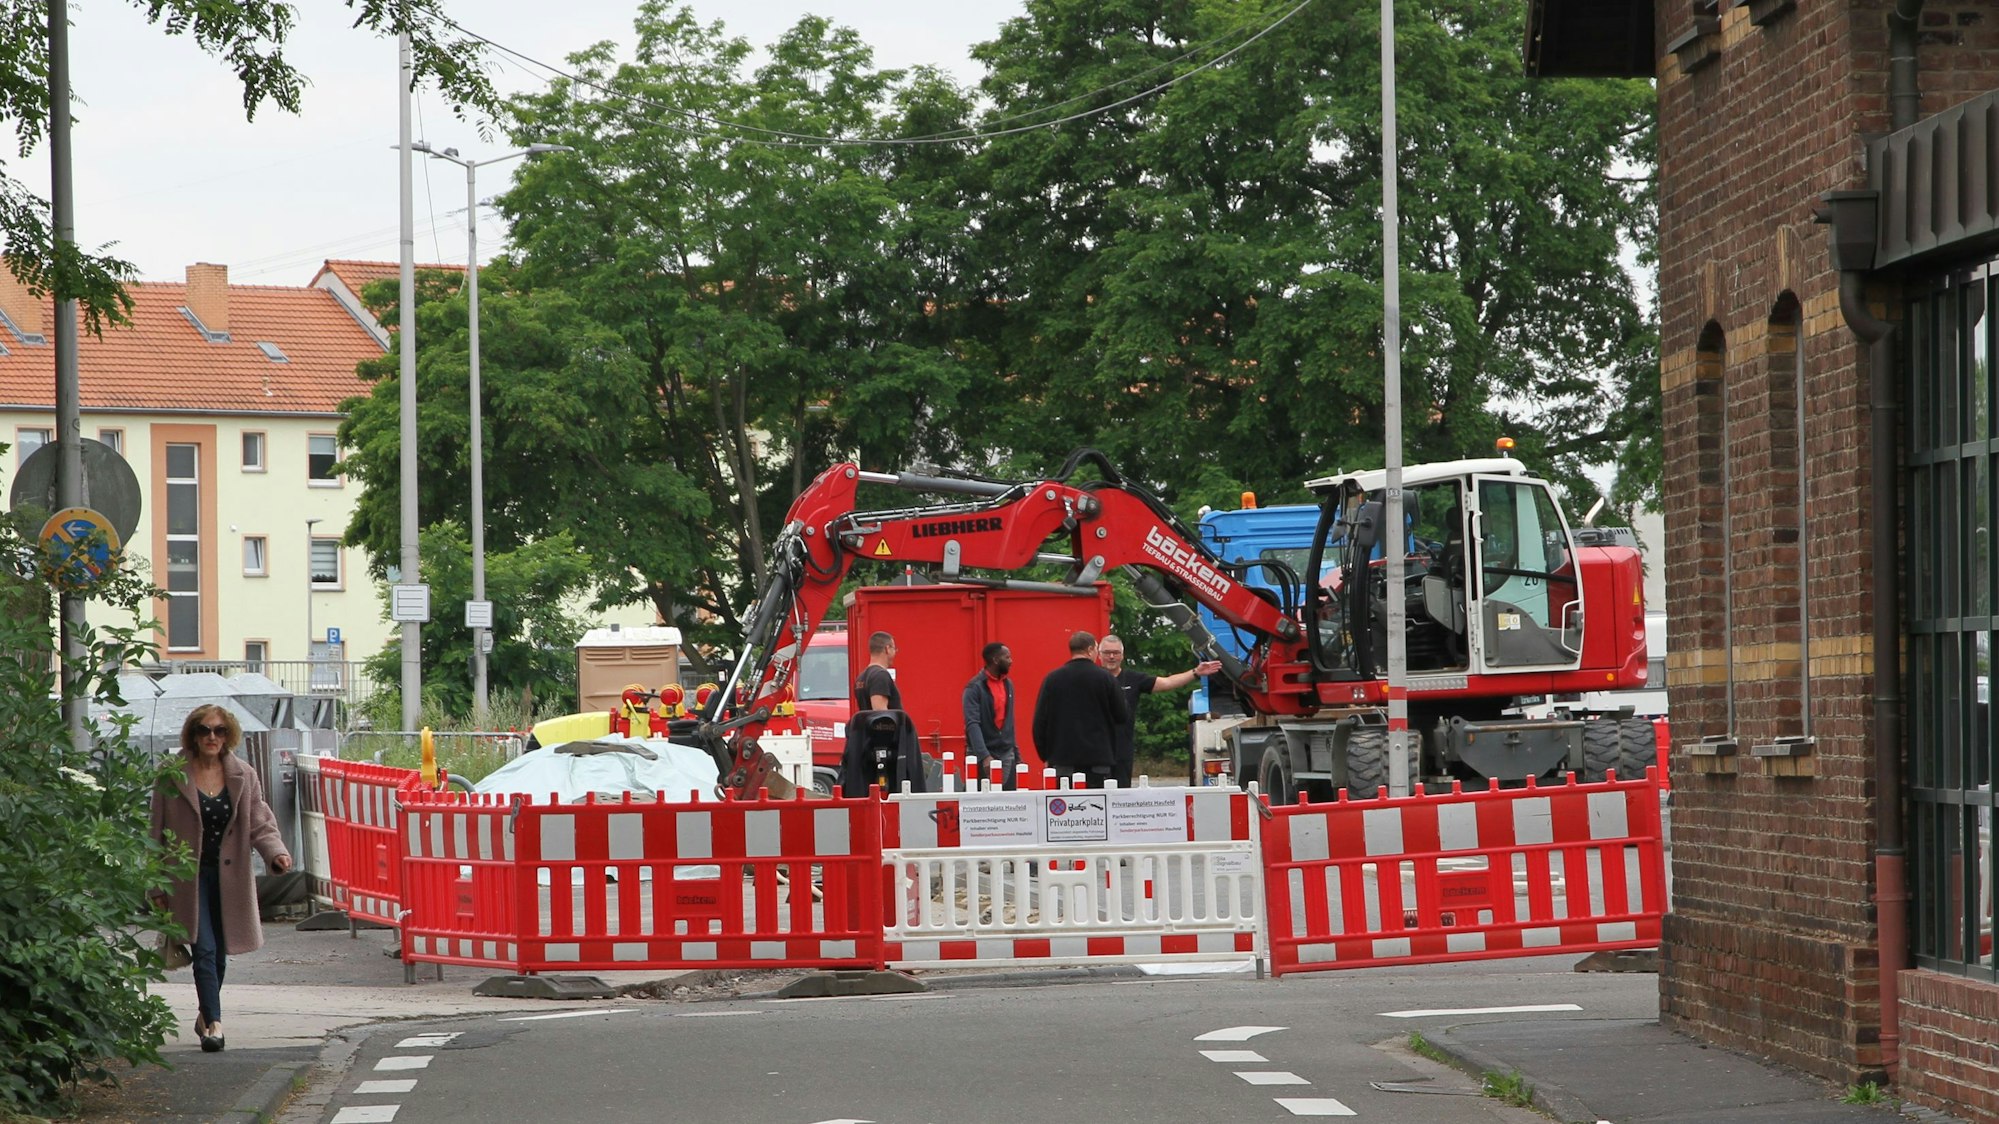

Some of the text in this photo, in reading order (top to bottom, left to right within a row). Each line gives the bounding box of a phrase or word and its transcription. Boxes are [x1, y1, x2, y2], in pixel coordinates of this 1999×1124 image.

[912, 517, 1003, 538] LIEBHERR
[1142, 542, 1224, 602] TIEFBAU & STRASSENBAU
[1050, 817, 1104, 828] Privatparkplatz
